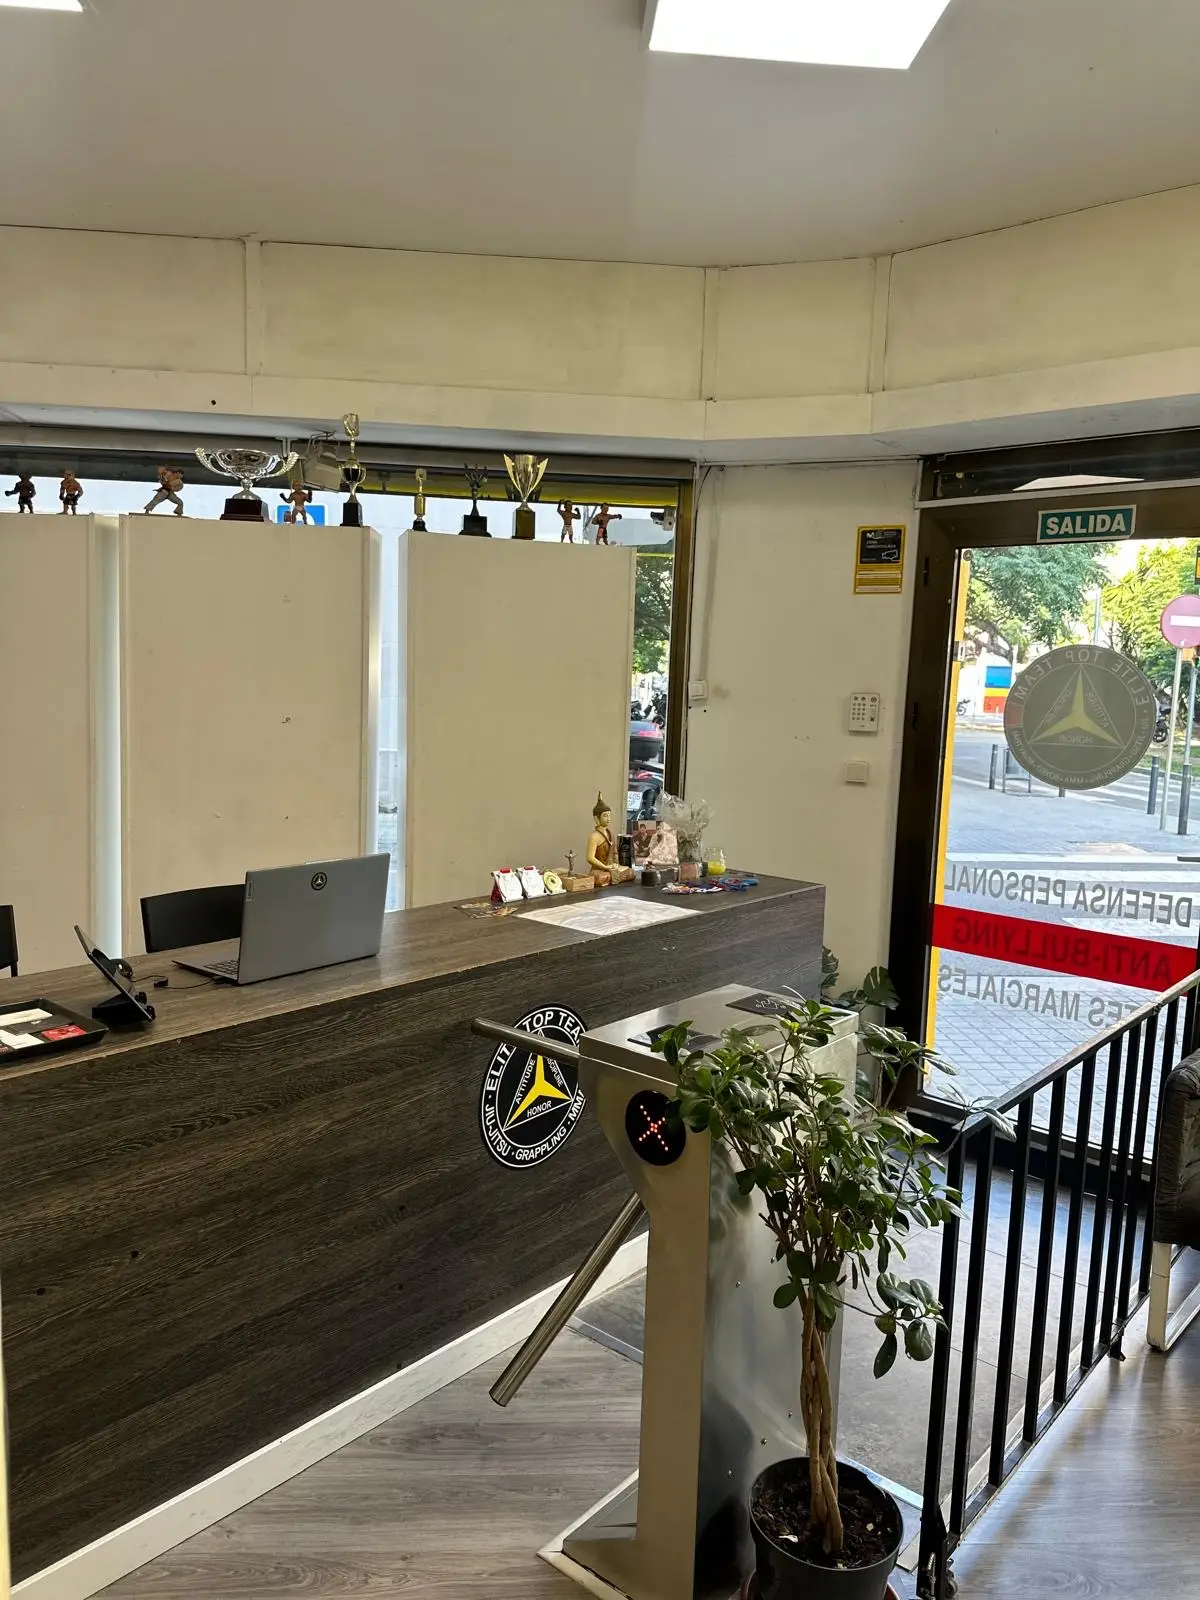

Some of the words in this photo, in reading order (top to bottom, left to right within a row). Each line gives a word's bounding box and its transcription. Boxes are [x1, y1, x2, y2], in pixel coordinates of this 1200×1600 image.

[1046, 513, 1126, 535] SALIDA
[486, 1043, 511, 1091] ELIT
[522, 1011, 554, 1033] TOP
[558, 1012, 581, 1043] TEA
[516, 1059, 536, 1105] ATTITUDE
[526, 1100, 552, 1118] HONOR
[485, 1104, 511, 1157] JIU-JITSU
[515, 1126, 567, 1161] GRAPPLING
